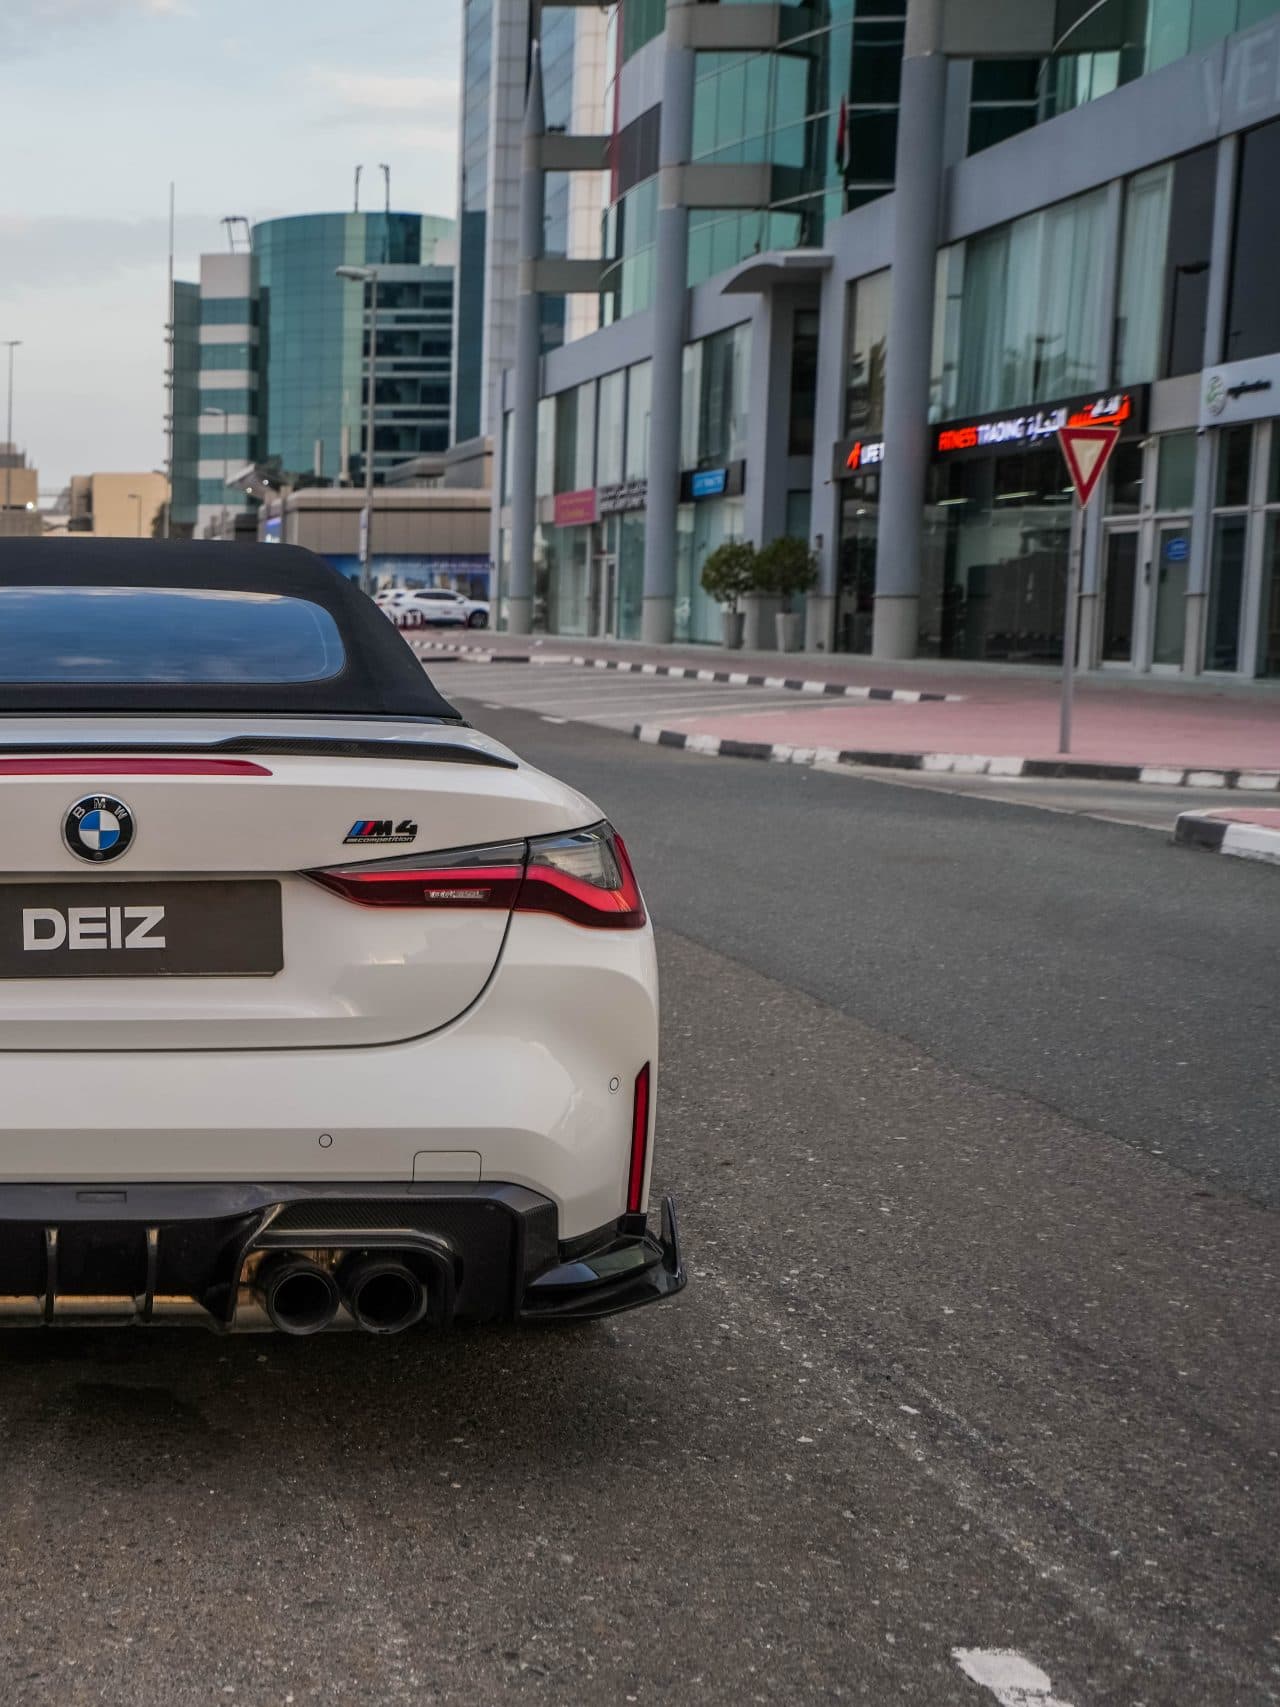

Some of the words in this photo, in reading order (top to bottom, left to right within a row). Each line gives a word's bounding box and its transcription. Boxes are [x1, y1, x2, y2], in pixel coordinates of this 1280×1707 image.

[1203, 28, 1280, 126] VE
[72, 797, 128, 820] BMW
[362, 820, 418, 836] M4
[22, 905, 166, 951] DEIZ
